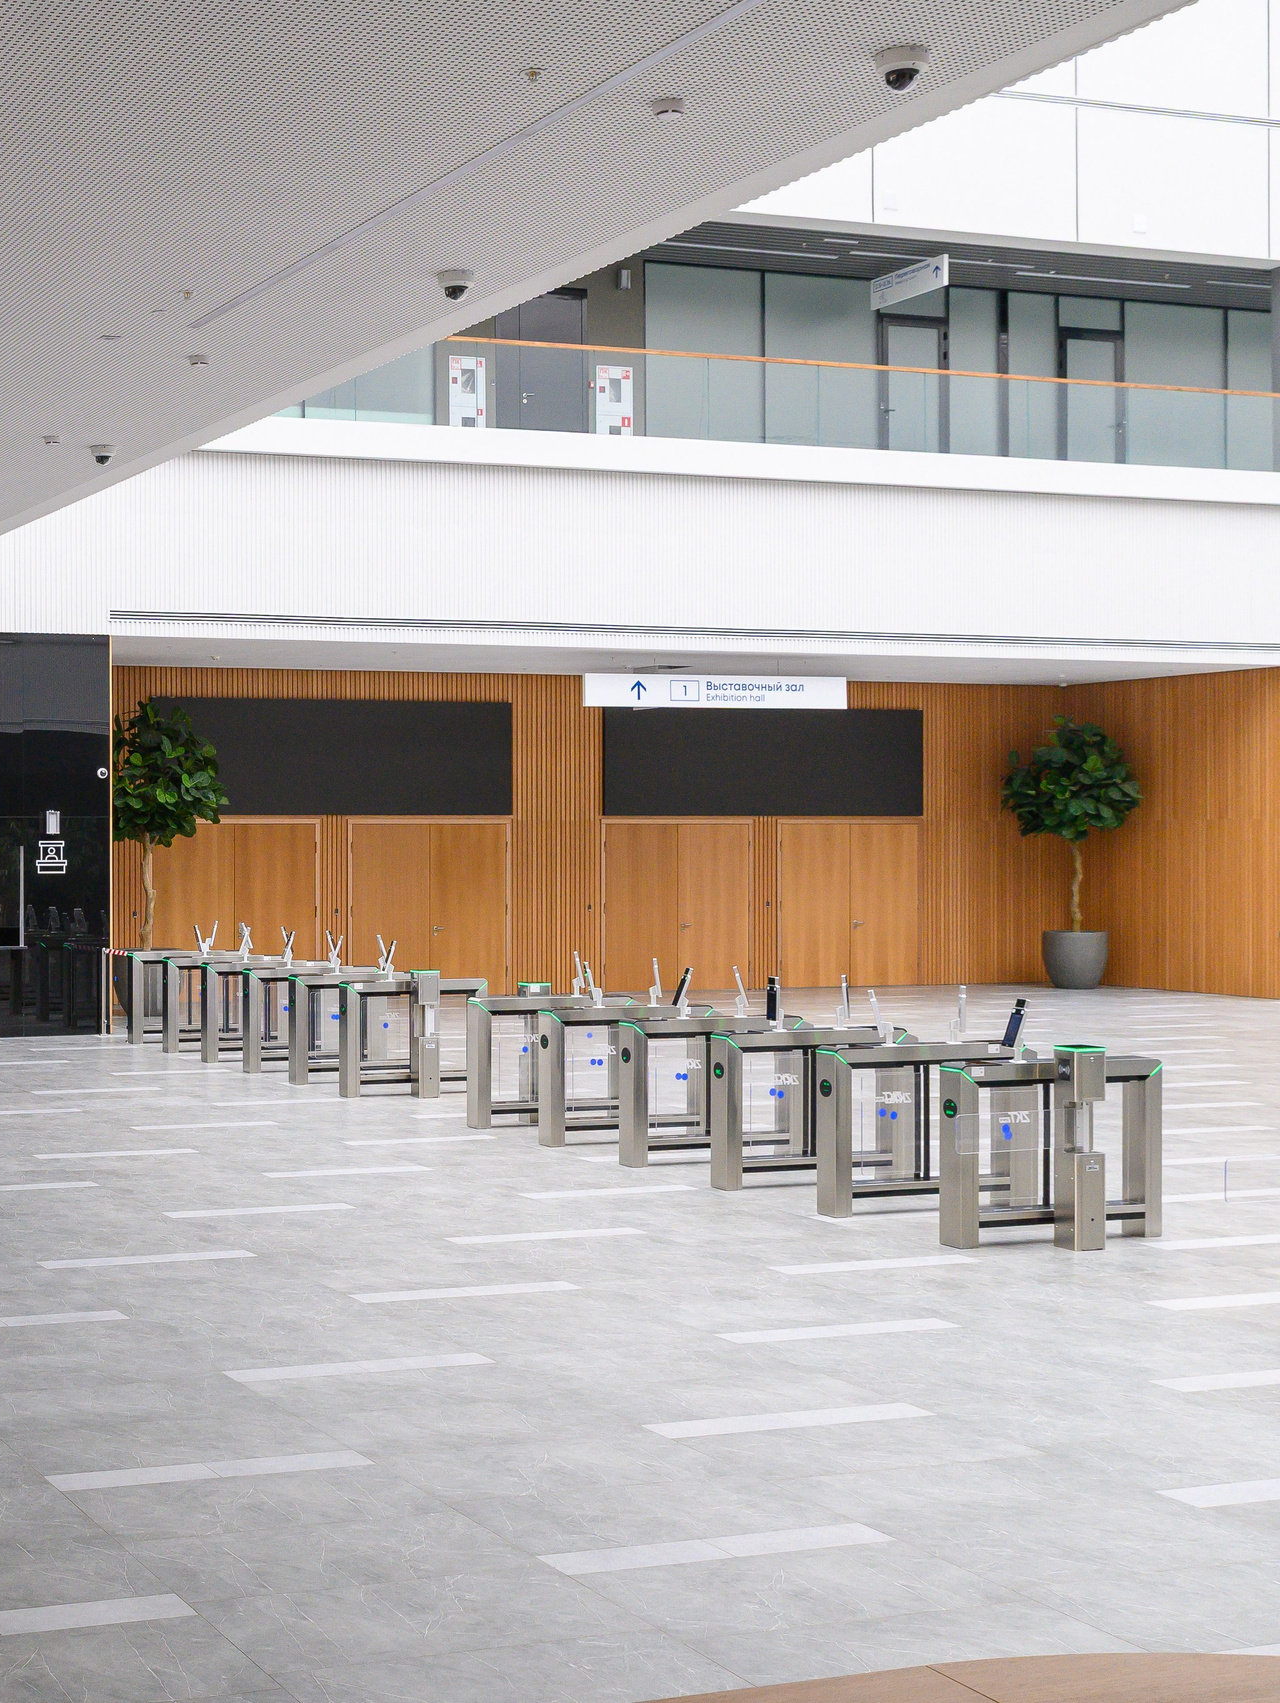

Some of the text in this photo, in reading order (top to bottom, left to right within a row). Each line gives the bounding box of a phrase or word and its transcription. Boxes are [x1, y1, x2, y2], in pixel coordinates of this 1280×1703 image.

[682, 685, 688, 697] 1
[706, 681, 805, 692] Выставочный зал
[706, 693, 766, 702] Exhibition hall
